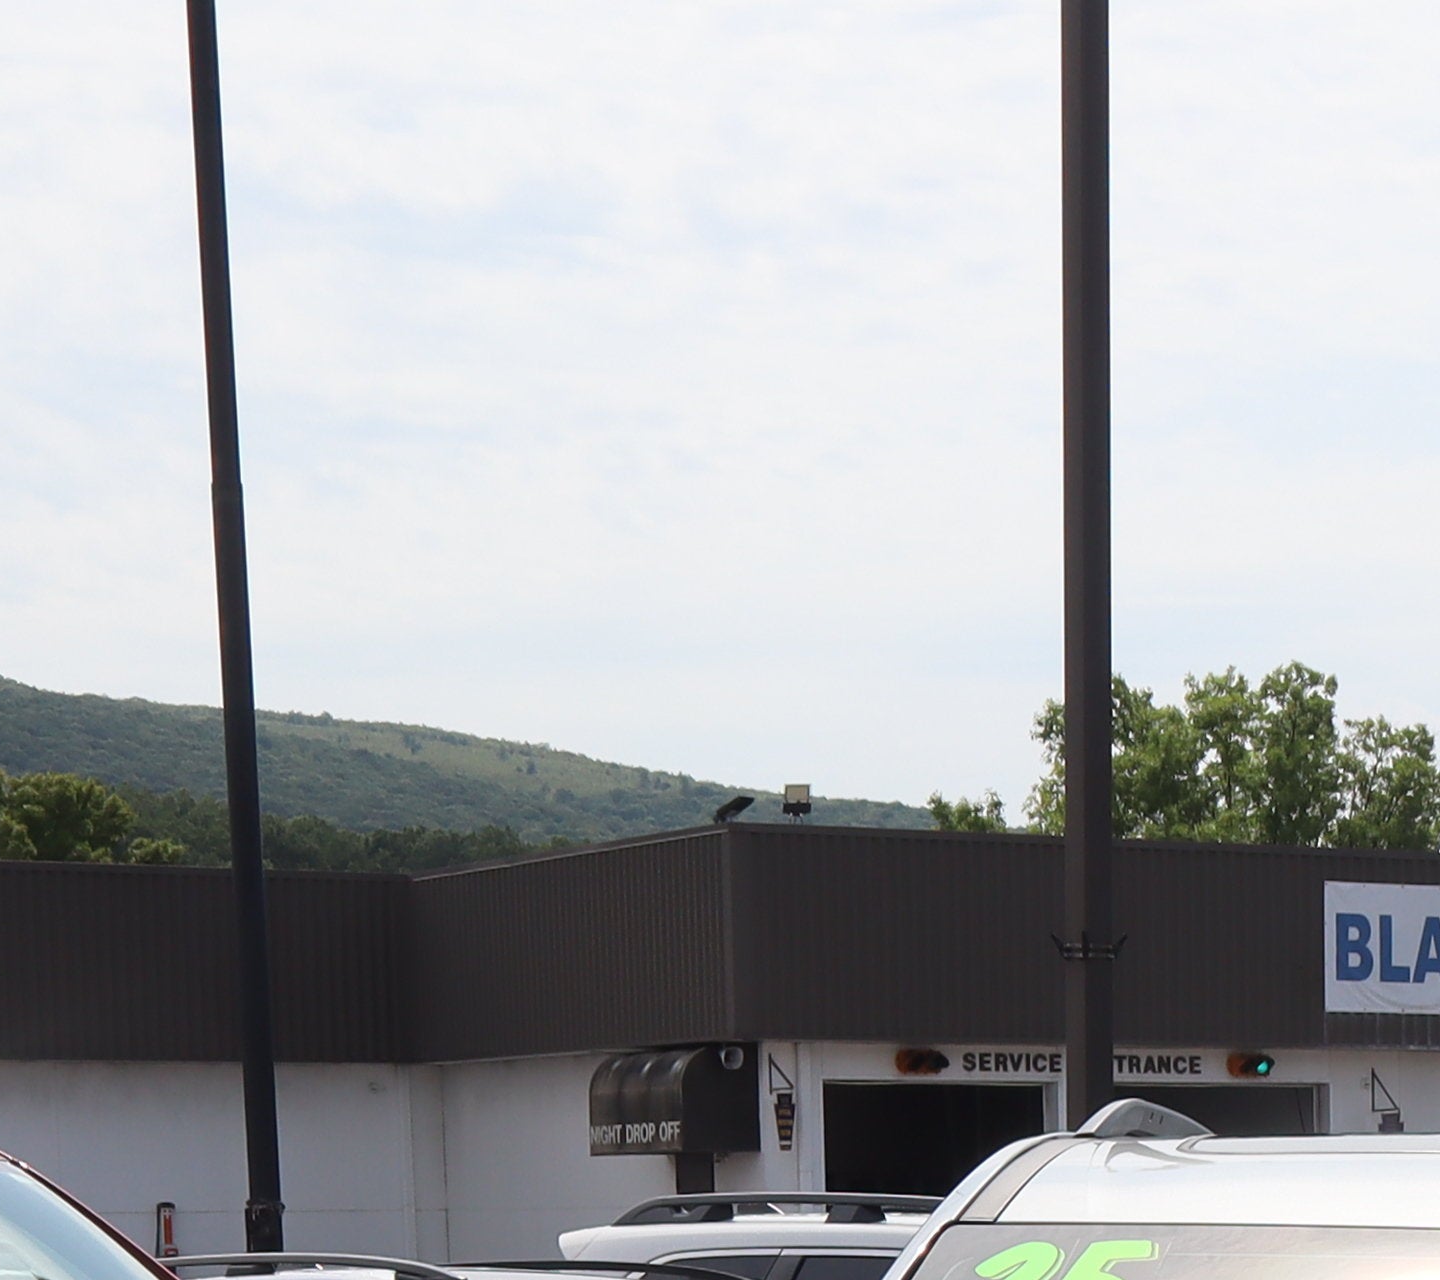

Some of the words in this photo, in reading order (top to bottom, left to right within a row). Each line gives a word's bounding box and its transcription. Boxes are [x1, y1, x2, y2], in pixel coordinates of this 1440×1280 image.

[962, 1052, 1062, 1073] SERVICE
[1113, 1054, 1202, 1074] TRANCE
[590, 1124, 622, 1145] NIGHT
[625, 1121, 655, 1144] DROP
[659, 1120, 681, 1142] OFF
